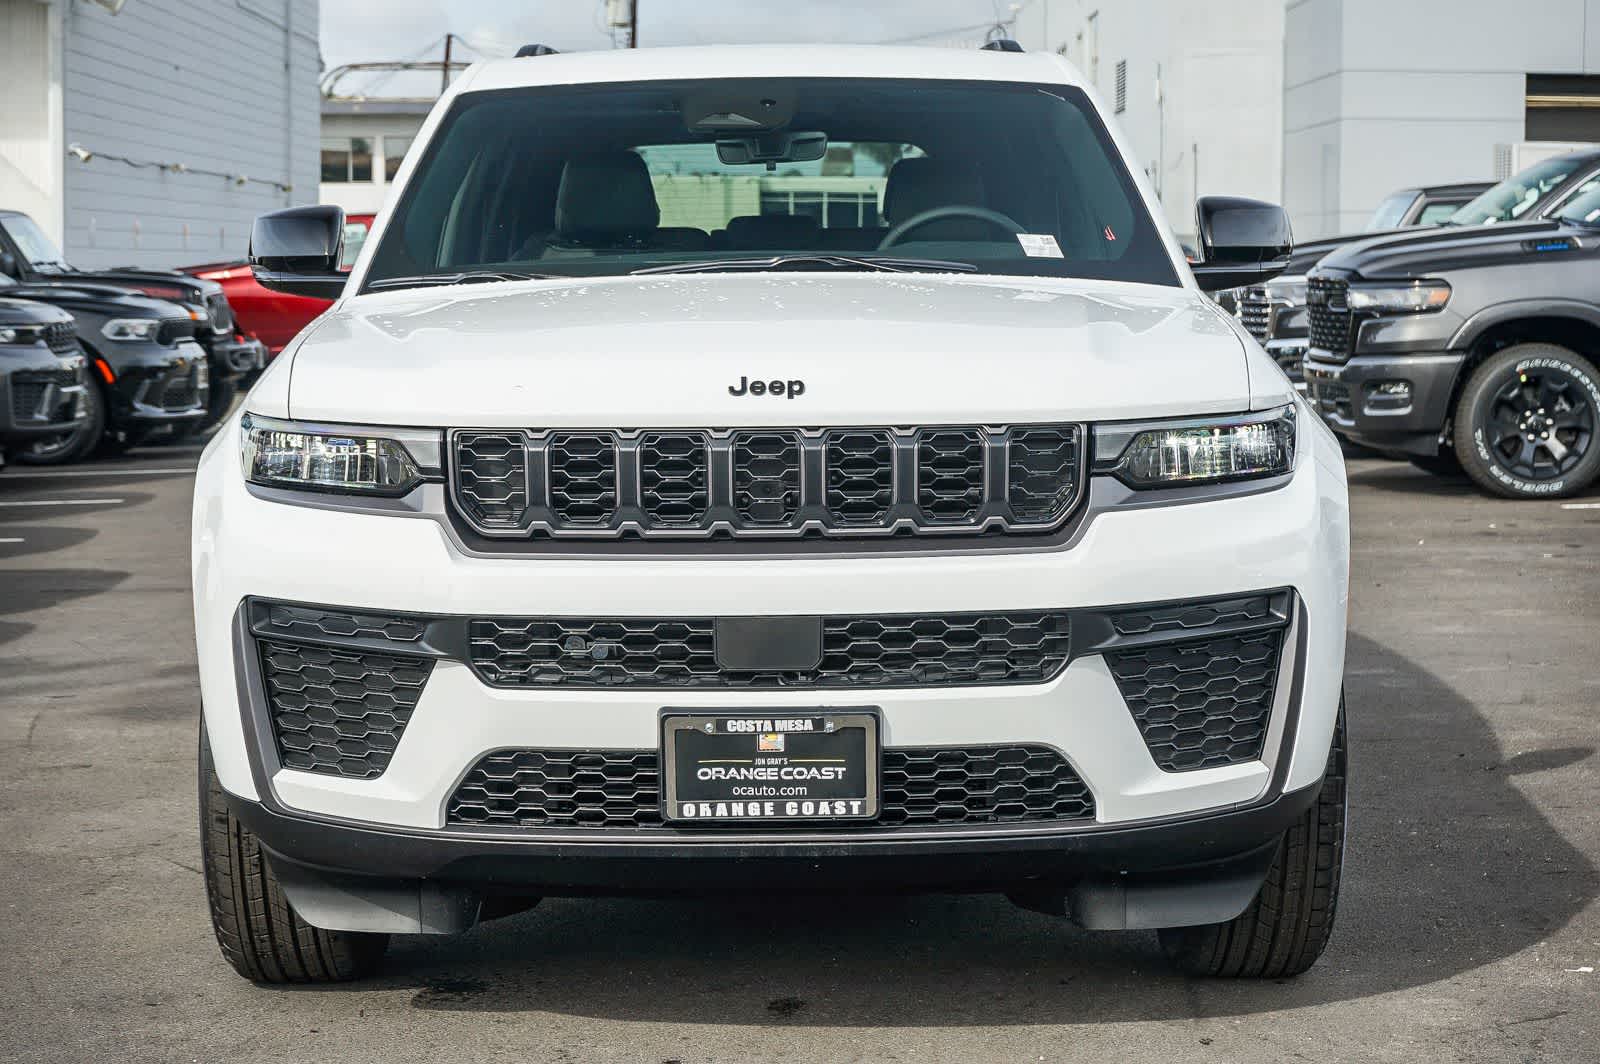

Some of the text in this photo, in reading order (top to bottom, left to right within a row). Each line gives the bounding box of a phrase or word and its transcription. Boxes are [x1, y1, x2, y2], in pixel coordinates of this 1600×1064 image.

[728, 376, 806, 399] Jeep
[727, 719, 813, 732] COSTA MESA
[767, 757, 788, 765] GRAY'S
[697, 767, 847, 780] ORANGE COAST
[732, 785, 808, 796] ocauto.com
[682, 801, 862, 817] ORANGE COAST
